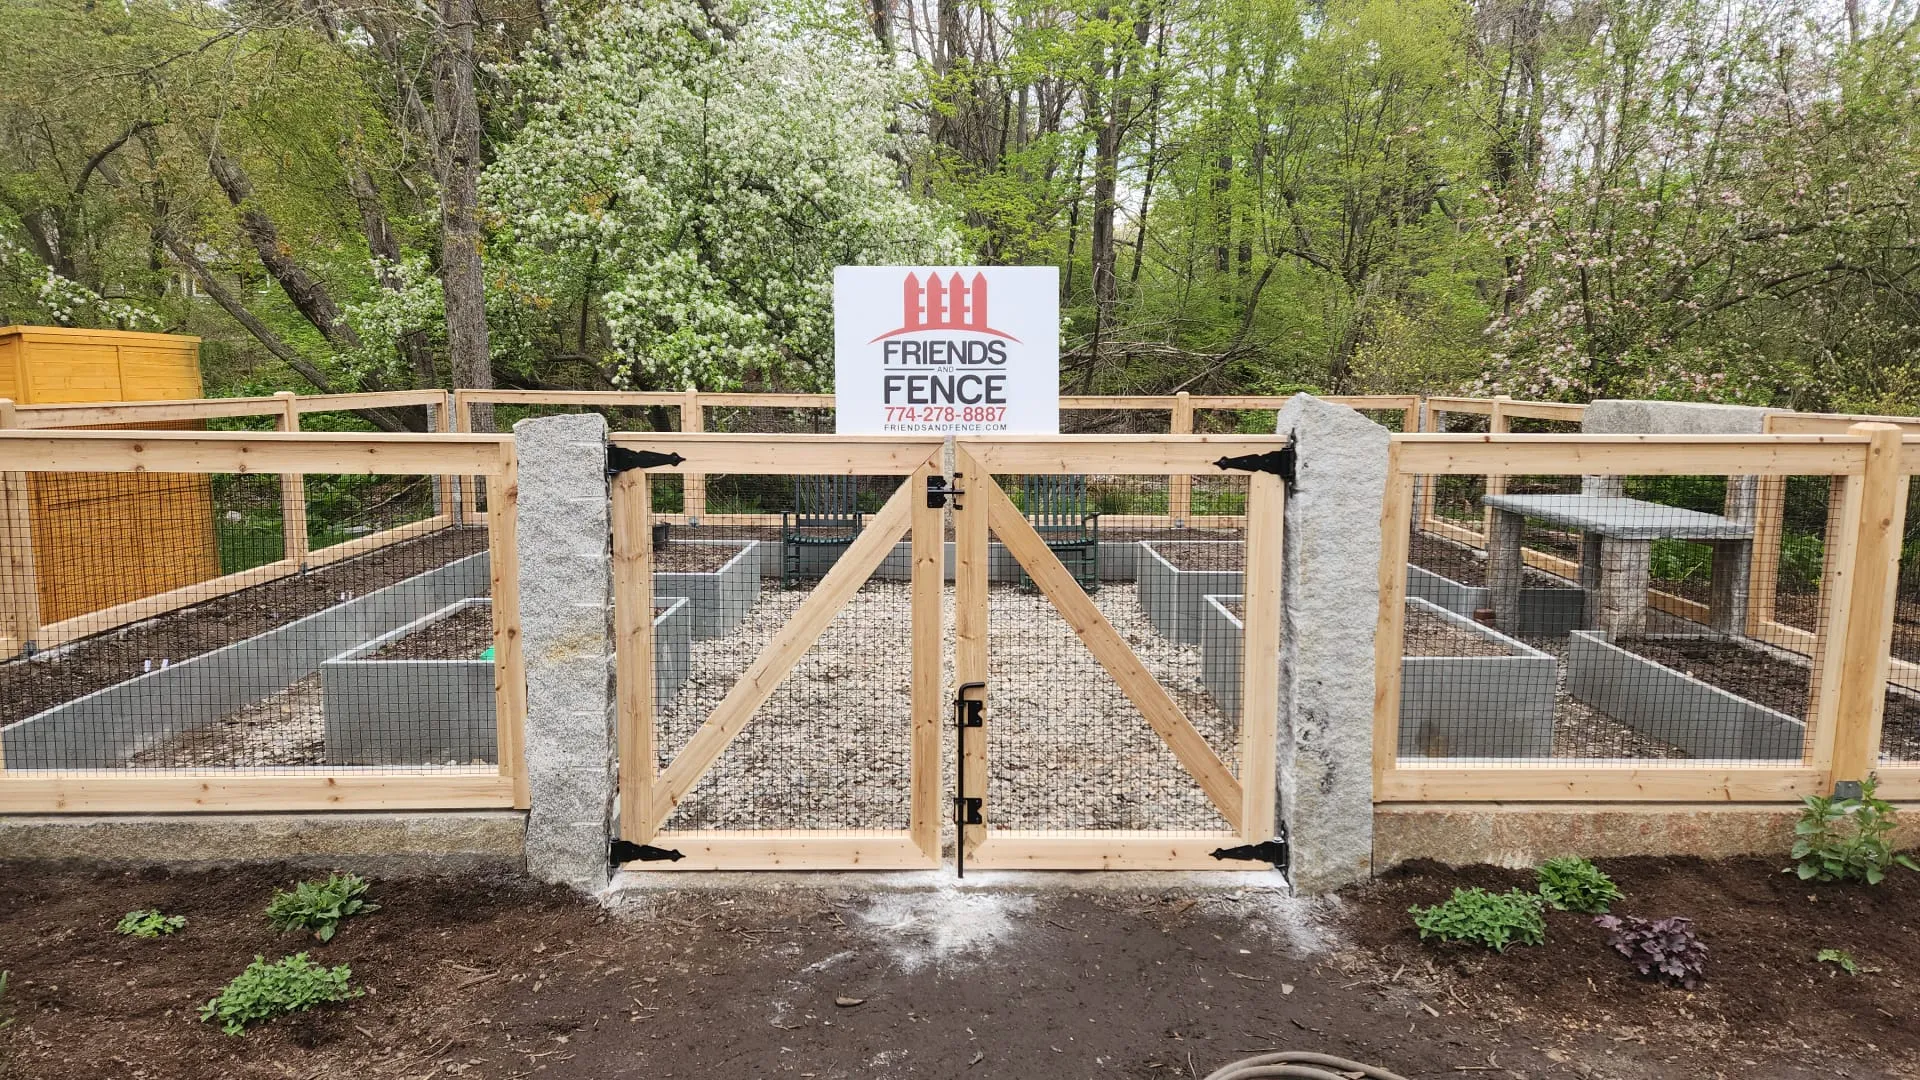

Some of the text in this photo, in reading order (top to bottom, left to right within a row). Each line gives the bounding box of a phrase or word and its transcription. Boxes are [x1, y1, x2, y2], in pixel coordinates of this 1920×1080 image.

[884, 340, 1007, 365] FRIENDS
[884, 374, 1007, 405] FENCE
[884, 406, 1007, 422] 774-278-8887
[884, 423, 1007, 432] FRIENDSANDFENCE.COM
